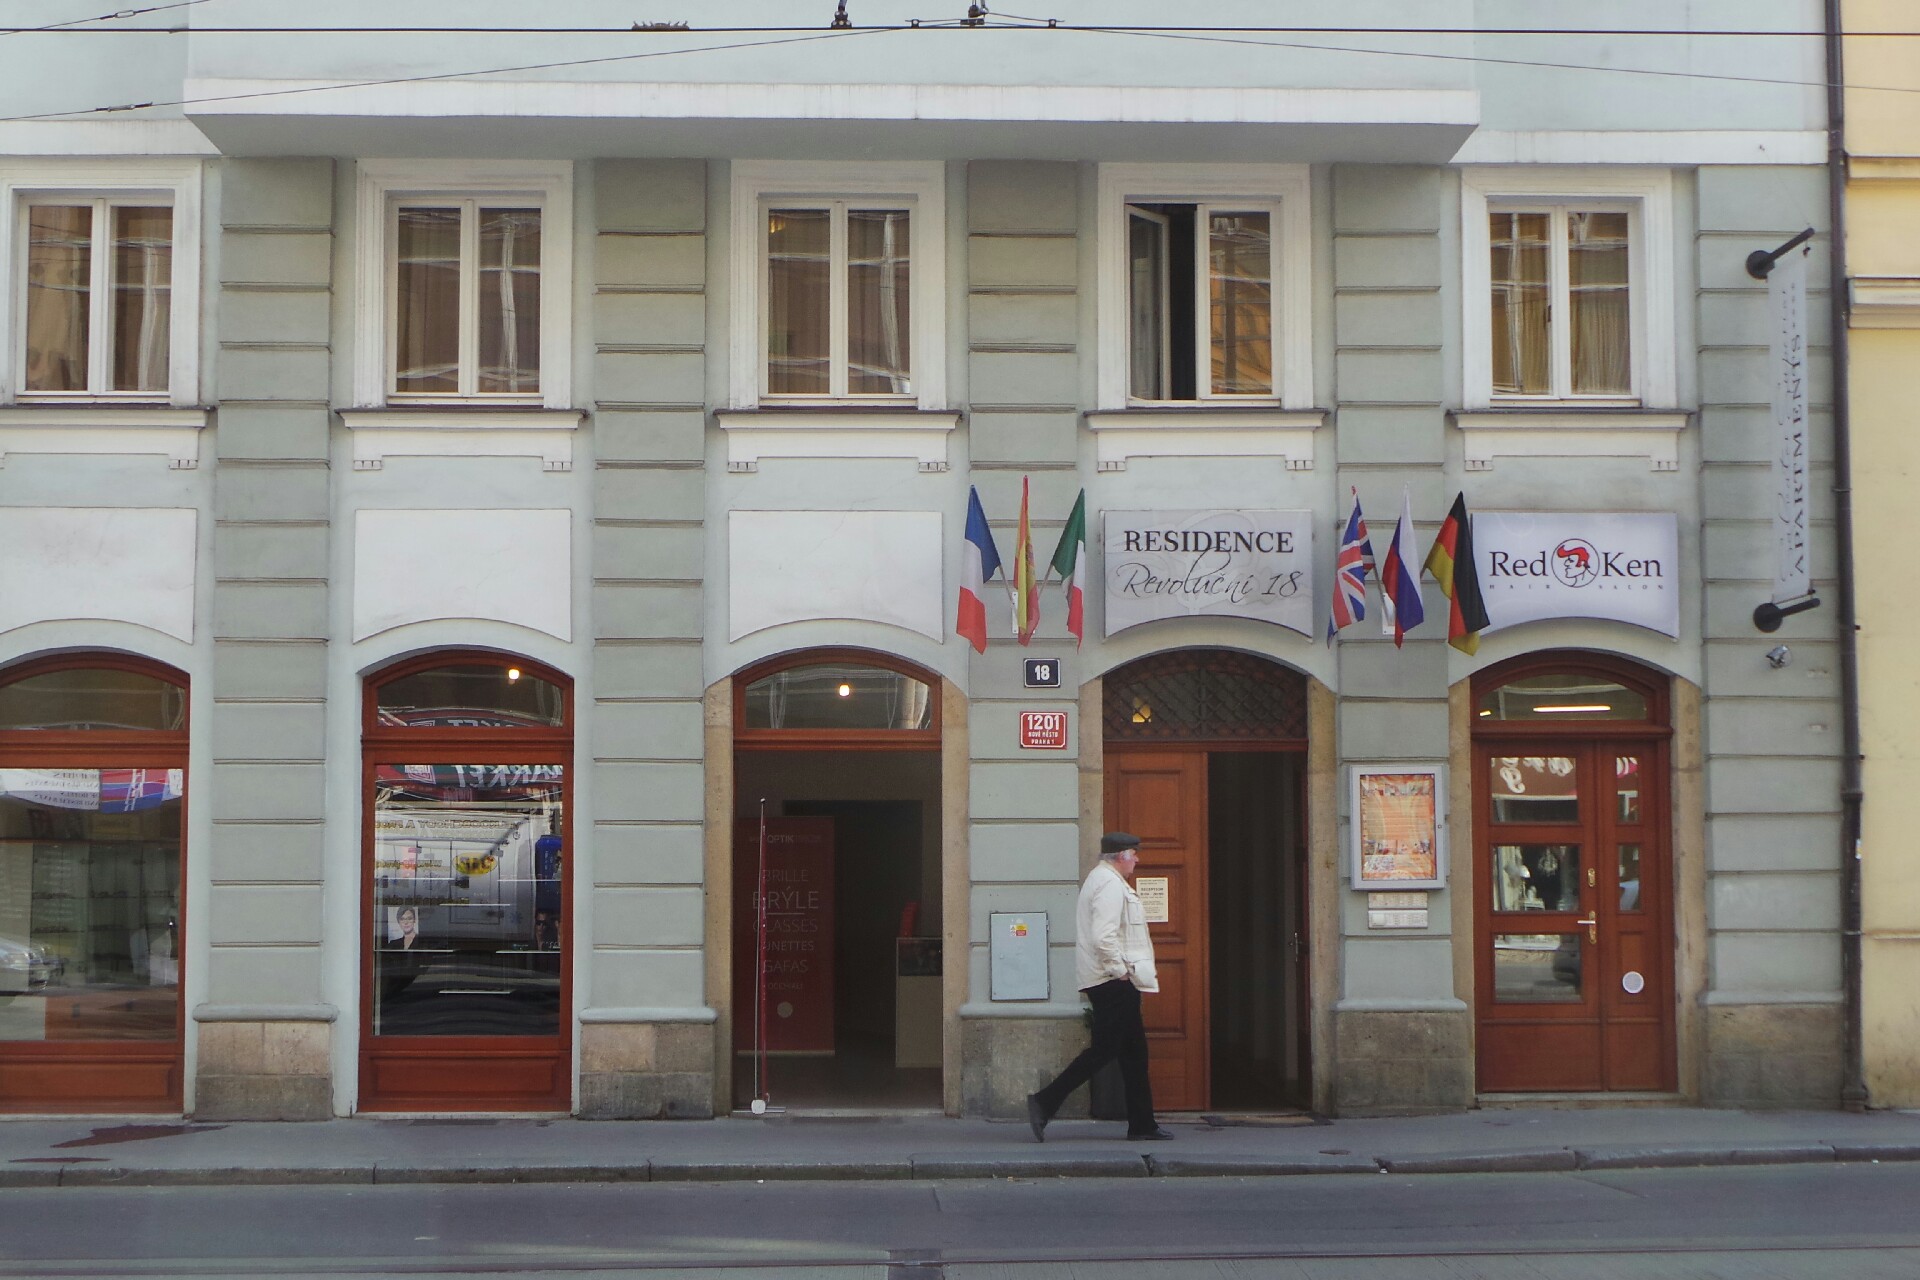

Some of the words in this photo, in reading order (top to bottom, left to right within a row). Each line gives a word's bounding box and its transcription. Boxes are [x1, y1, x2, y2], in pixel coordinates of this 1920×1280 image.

[1124, 530, 1294, 553] RESIDENCE
[1116, 547, 1255, 603] Revoluční
[1261, 571, 1304, 596] 18
[1489, 551, 1549, 577] Red
[1602, 552, 1663, 577] Ken
[1034, 664, 1050, 681] 18
[1027, 714, 1060, 730] 1201
